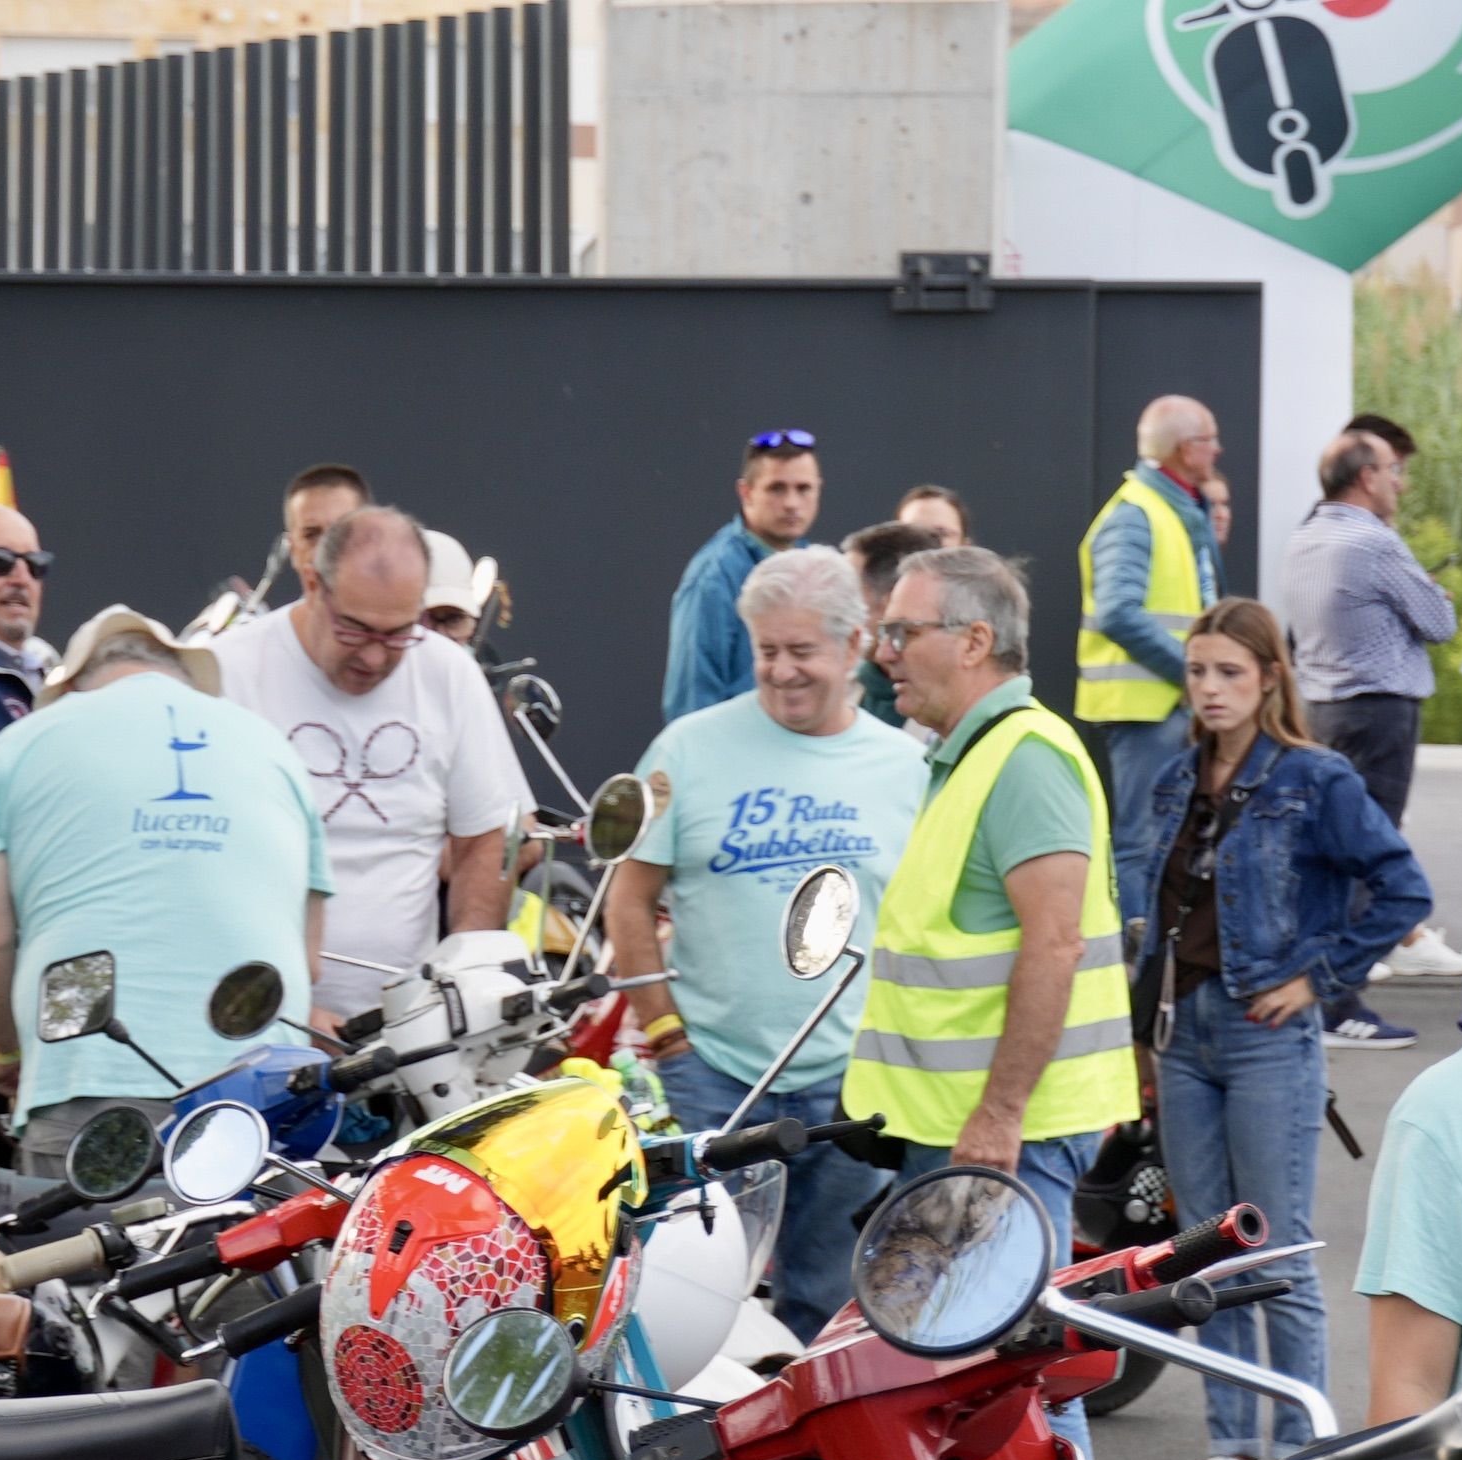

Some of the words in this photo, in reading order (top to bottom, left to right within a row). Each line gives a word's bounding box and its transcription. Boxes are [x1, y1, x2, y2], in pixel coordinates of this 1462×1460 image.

[131, 807, 231, 834] lucena
[788, 795, 860, 824] Ruta
[708, 828, 880, 873] Subbética
